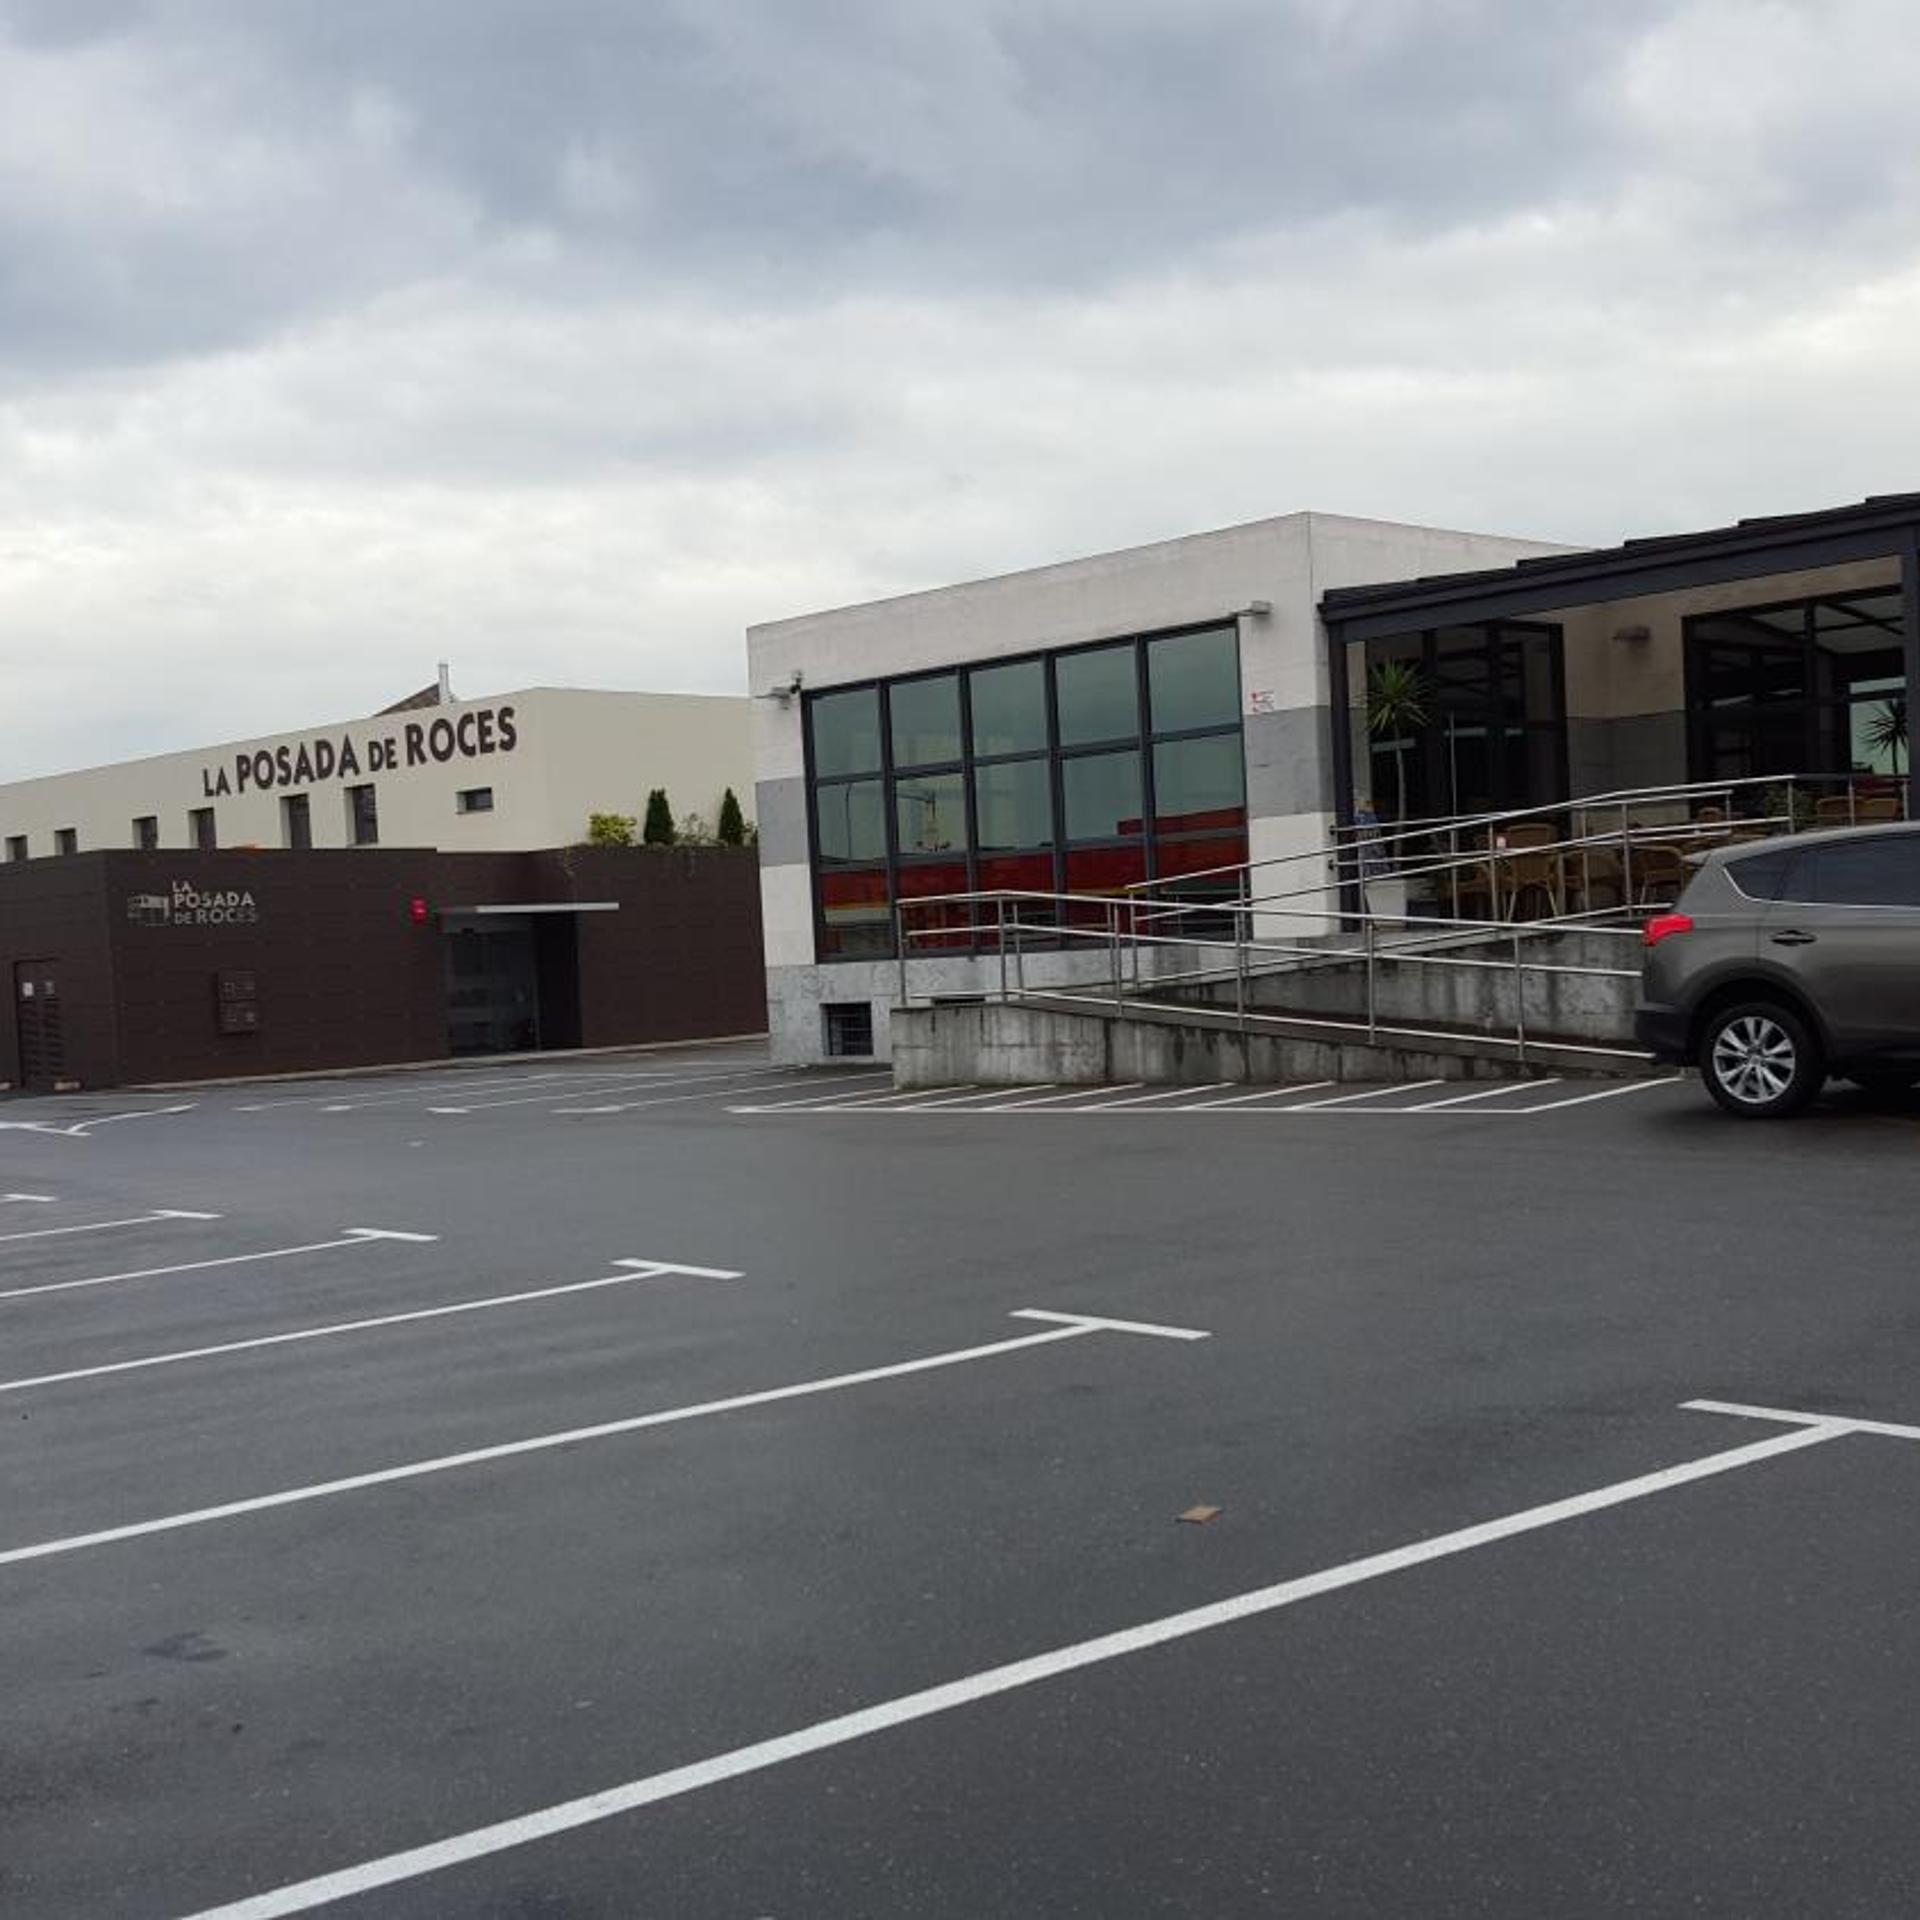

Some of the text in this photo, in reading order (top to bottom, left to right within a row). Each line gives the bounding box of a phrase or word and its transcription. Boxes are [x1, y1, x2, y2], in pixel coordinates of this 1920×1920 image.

[203, 706, 517, 797] LA POSADA DE ROCES
[172, 880, 192, 893] LA
[174, 891, 255, 908] POSADA
[174, 907, 257, 924] DE ROCES
